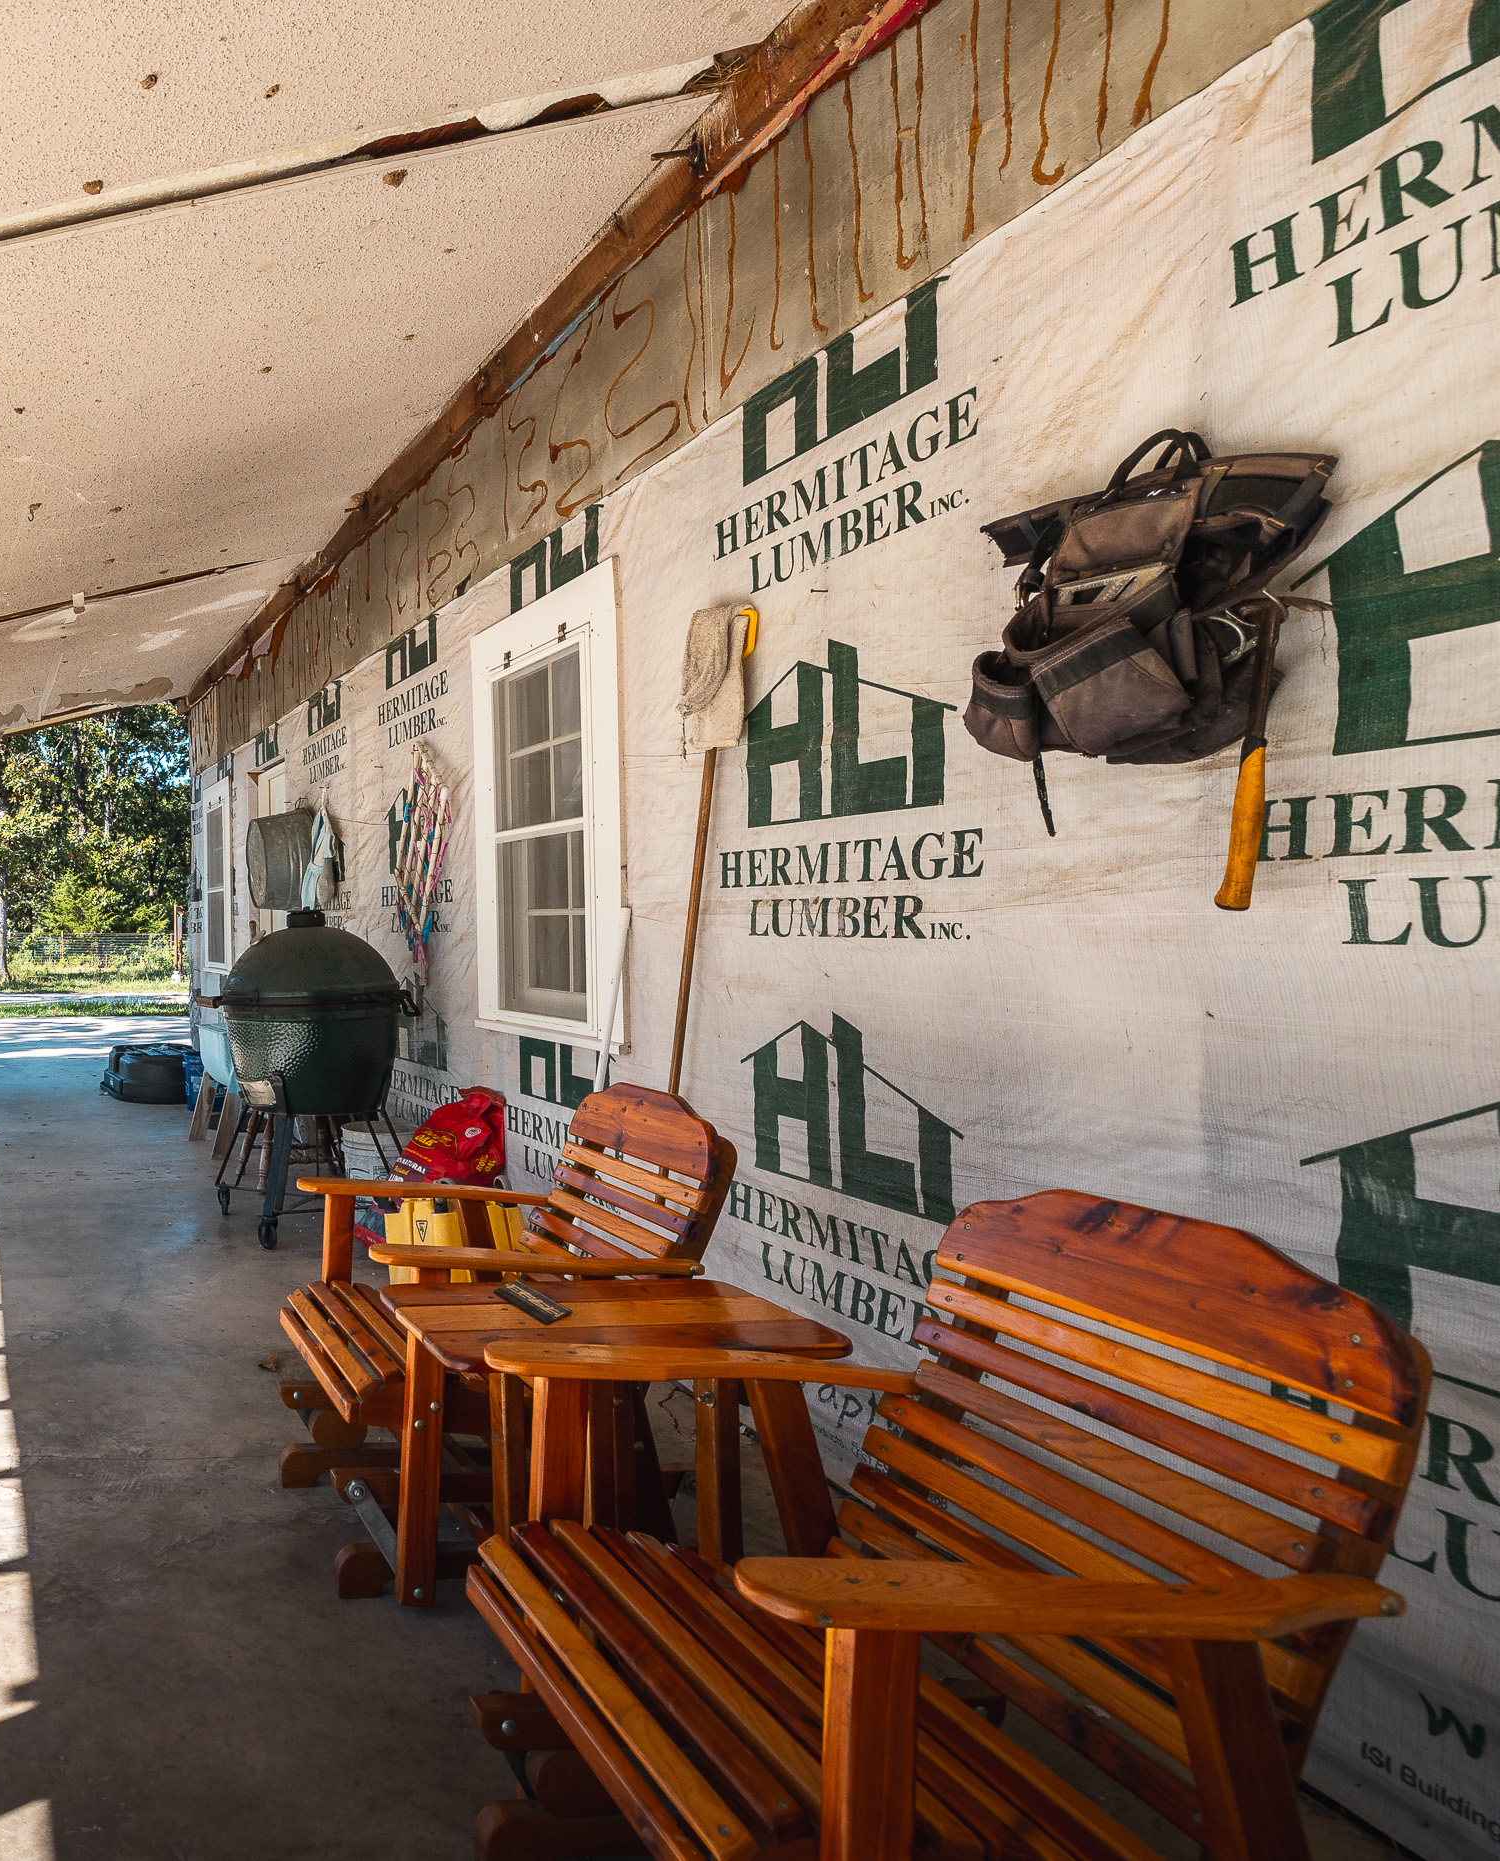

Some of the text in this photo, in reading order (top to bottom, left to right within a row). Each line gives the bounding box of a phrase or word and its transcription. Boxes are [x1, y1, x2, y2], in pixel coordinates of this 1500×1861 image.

[712, 387, 981, 562] HERMITAGE
[748, 479, 927, 597] LUMBER
[377, 669, 449, 727] HERMITAGE
[302, 726, 348, 767] HERMITAGE
[388, 707, 437, 749] LUMBER
[309, 754, 340, 785] LUMBER
[1257, 779, 1500, 864] HER
[718, 828, 985, 890] HERMITAGE
[748, 893, 927, 941] LUMBER
[391, 1068, 460, 1106] ERMITAGE
